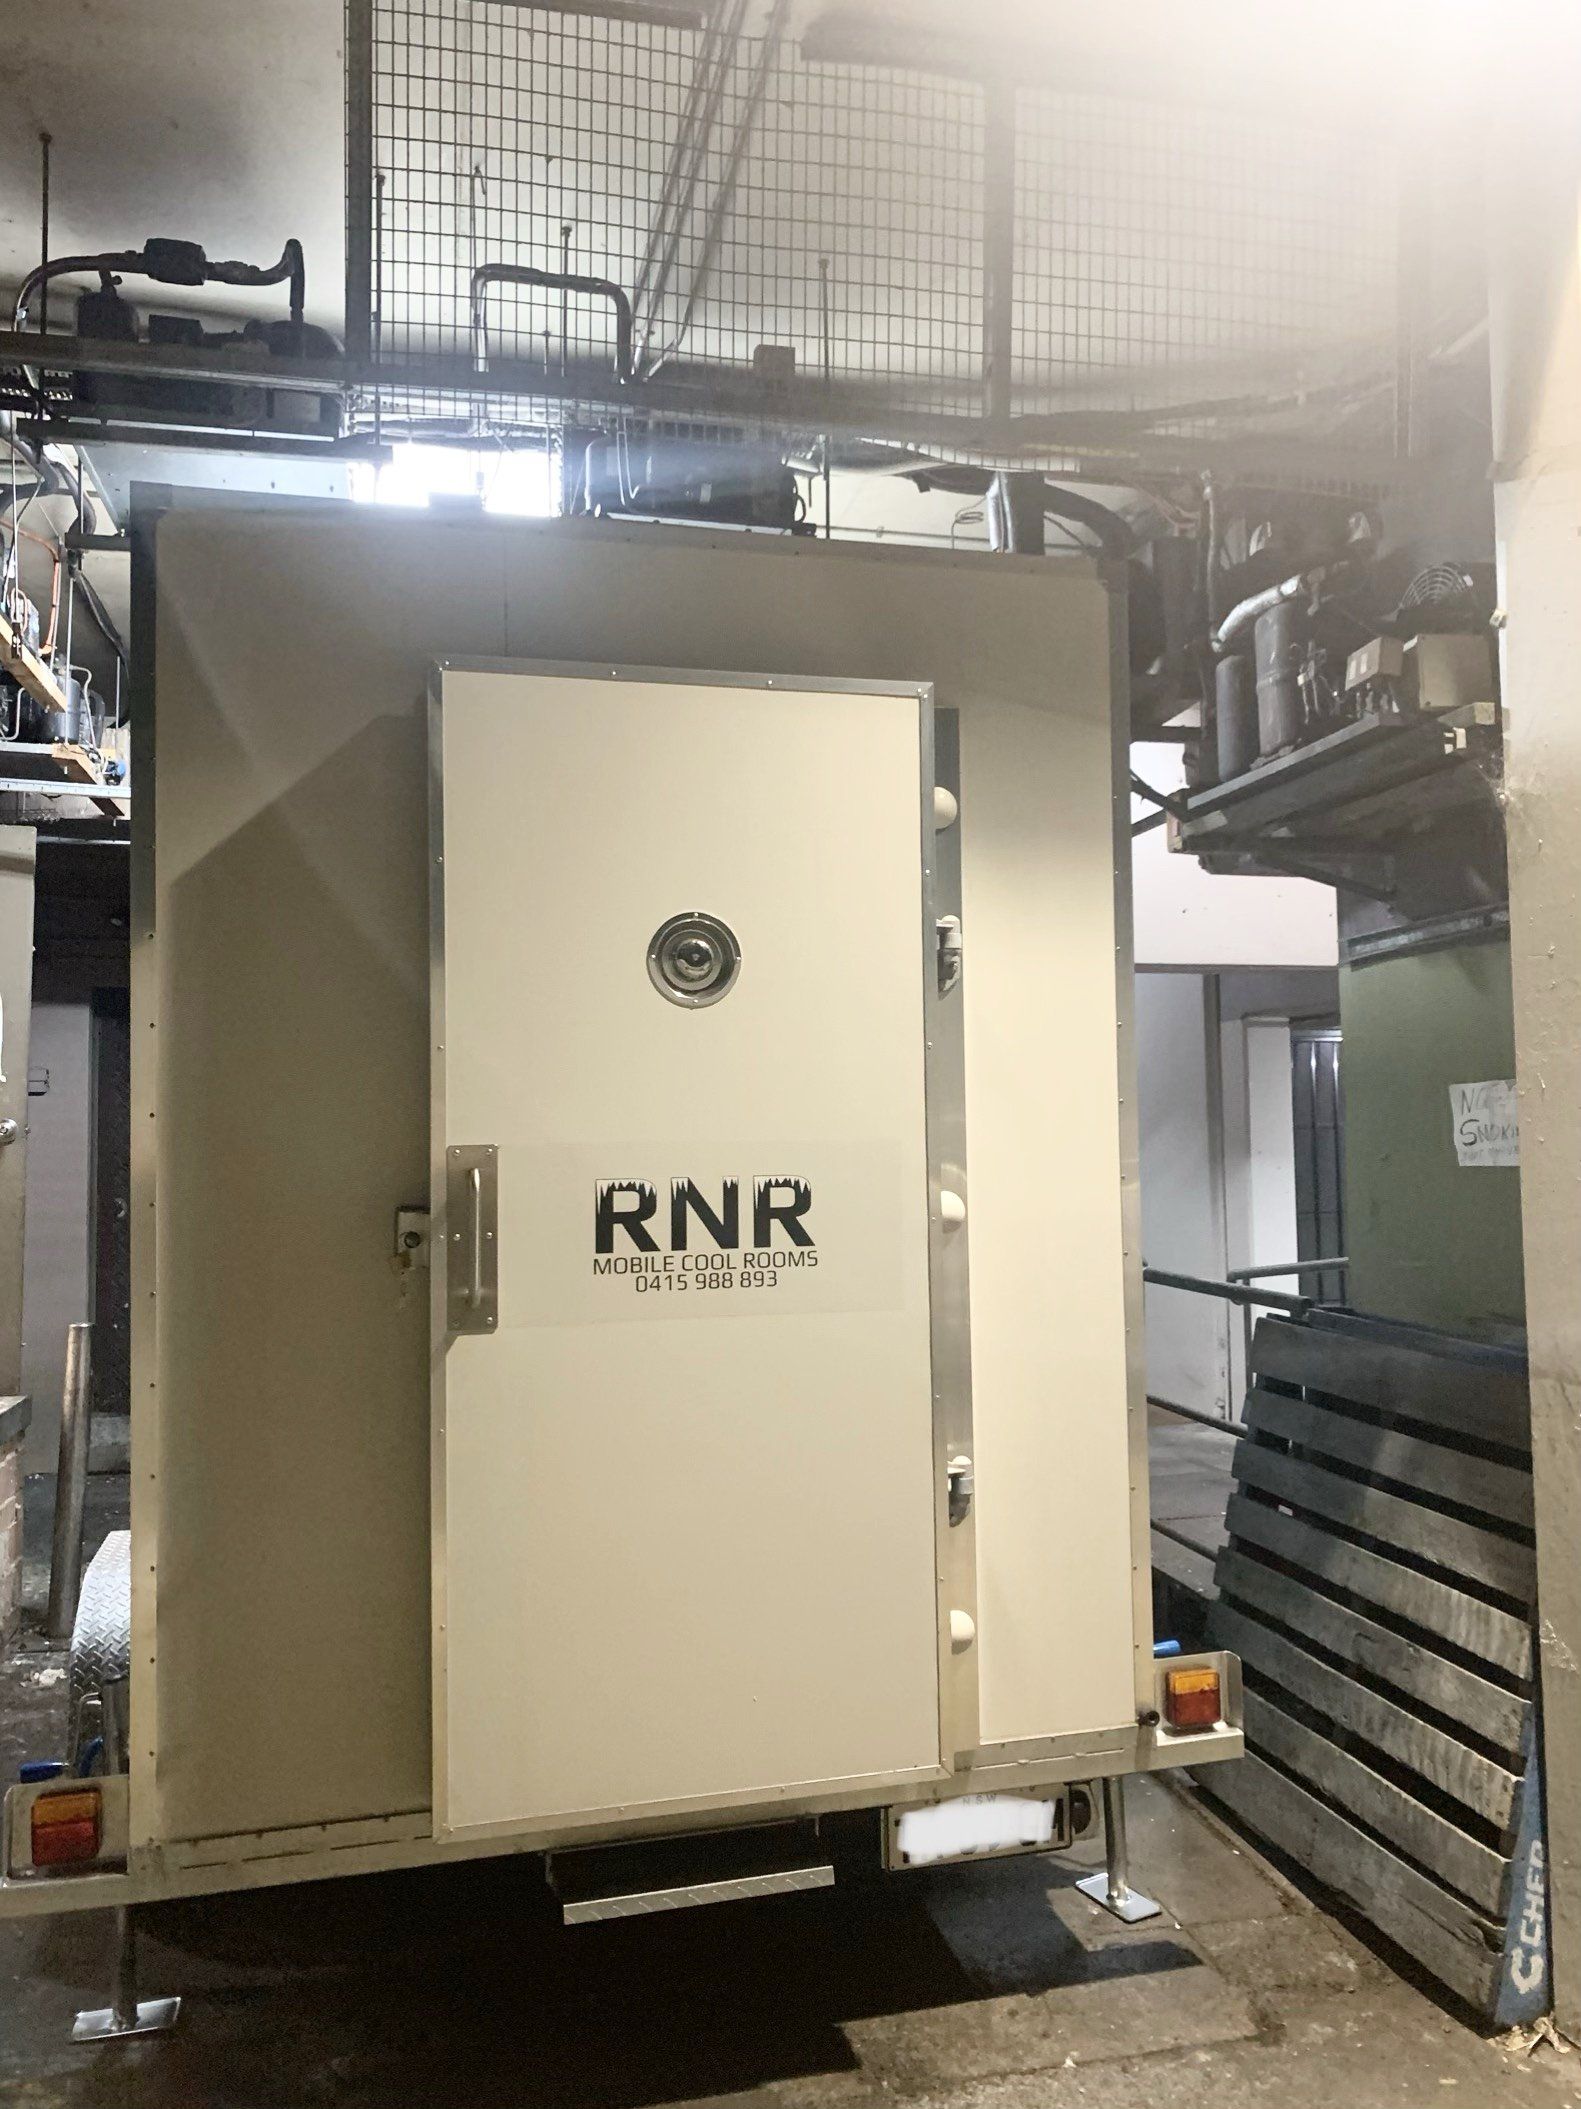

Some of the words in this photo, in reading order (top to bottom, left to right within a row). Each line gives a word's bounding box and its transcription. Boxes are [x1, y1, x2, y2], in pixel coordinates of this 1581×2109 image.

[595, 1174, 816, 1254] RNR
[593, 1255, 675, 1275] MOBILE
[681, 1253, 737, 1271] COOL
[743, 1250, 818, 1269] ROOMS
[635, 1275, 688, 1293] 0415
[695, 1272, 733, 1290] 988
[740, 1270, 778, 1288] 893
[962, 1793, 998, 1806] NSW
